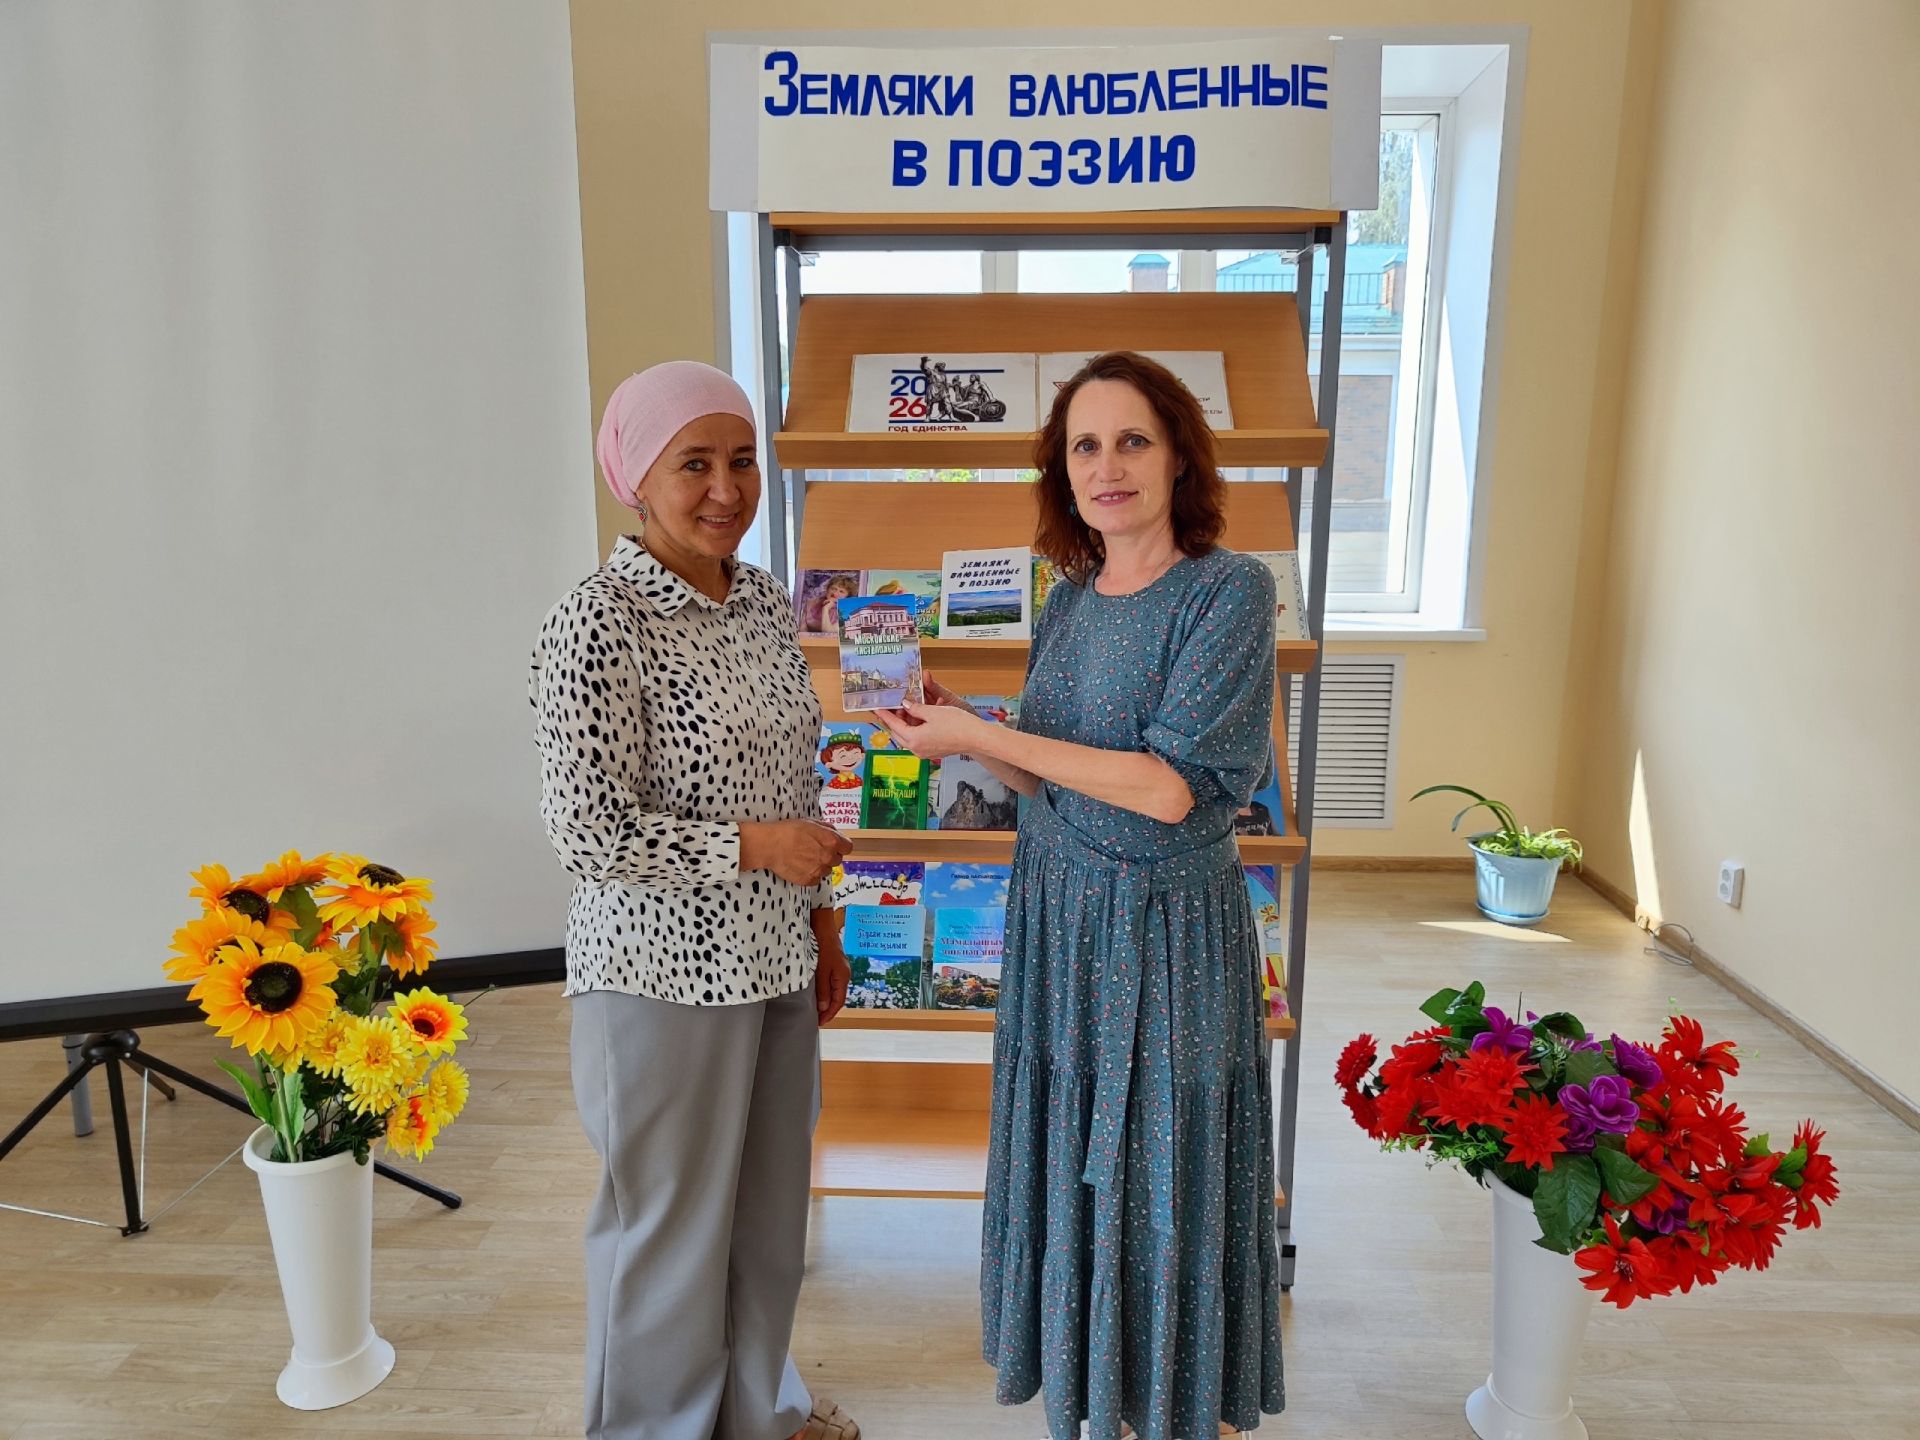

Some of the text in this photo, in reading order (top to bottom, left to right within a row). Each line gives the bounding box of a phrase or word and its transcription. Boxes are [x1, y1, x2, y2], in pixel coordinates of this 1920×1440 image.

[764, 51, 1327, 117] ЗЕМЛЯКИ ВЛЮБЛЕННЫЕ
[892, 134, 1195, 186] В ПОЭЗИЮ
[890, 375, 927, 396] 20
[889, 397, 927, 417] 26
[950, 568, 1021, 579] ВЛЮБЛЕННЫЕ
[960, 560, 1011, 569] ЗЕМЛЯКИ
[825, 801, 861, 809] ЖИРА
